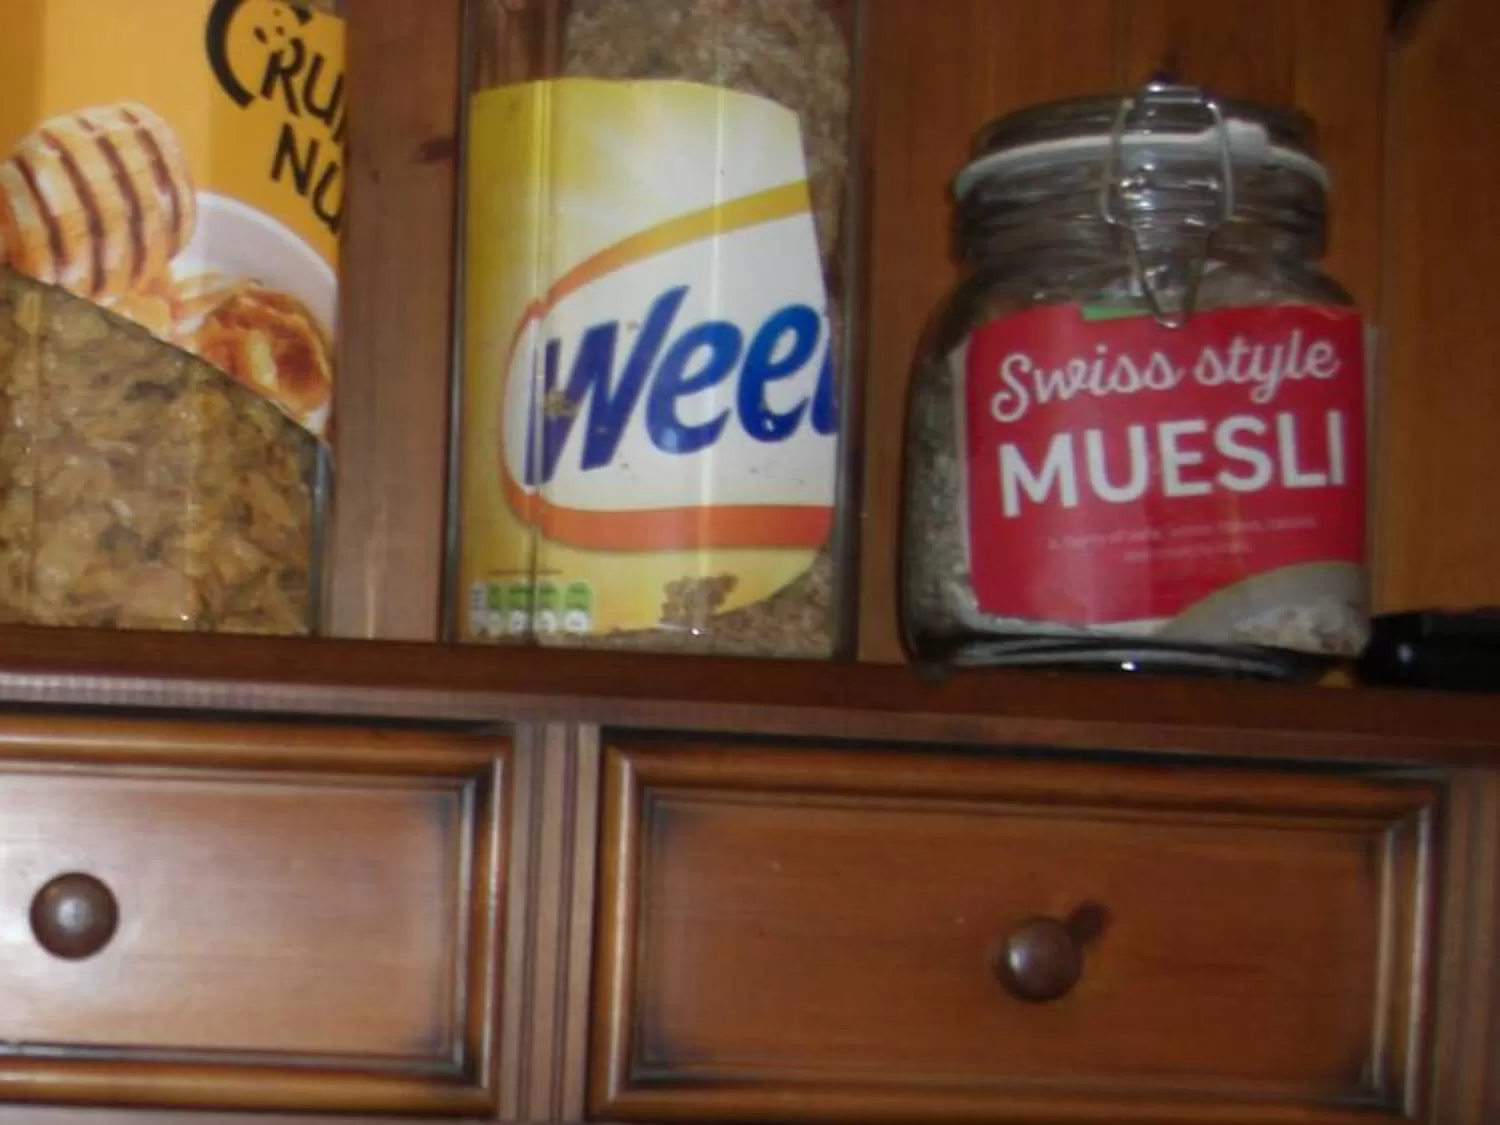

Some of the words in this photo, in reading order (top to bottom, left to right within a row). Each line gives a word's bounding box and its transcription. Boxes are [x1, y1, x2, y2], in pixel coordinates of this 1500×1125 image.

[990, 344, 1184, 423] Swiss
[1192, 328, 1342, 405] style
[999, 408, 1346, 519] MUESLI
